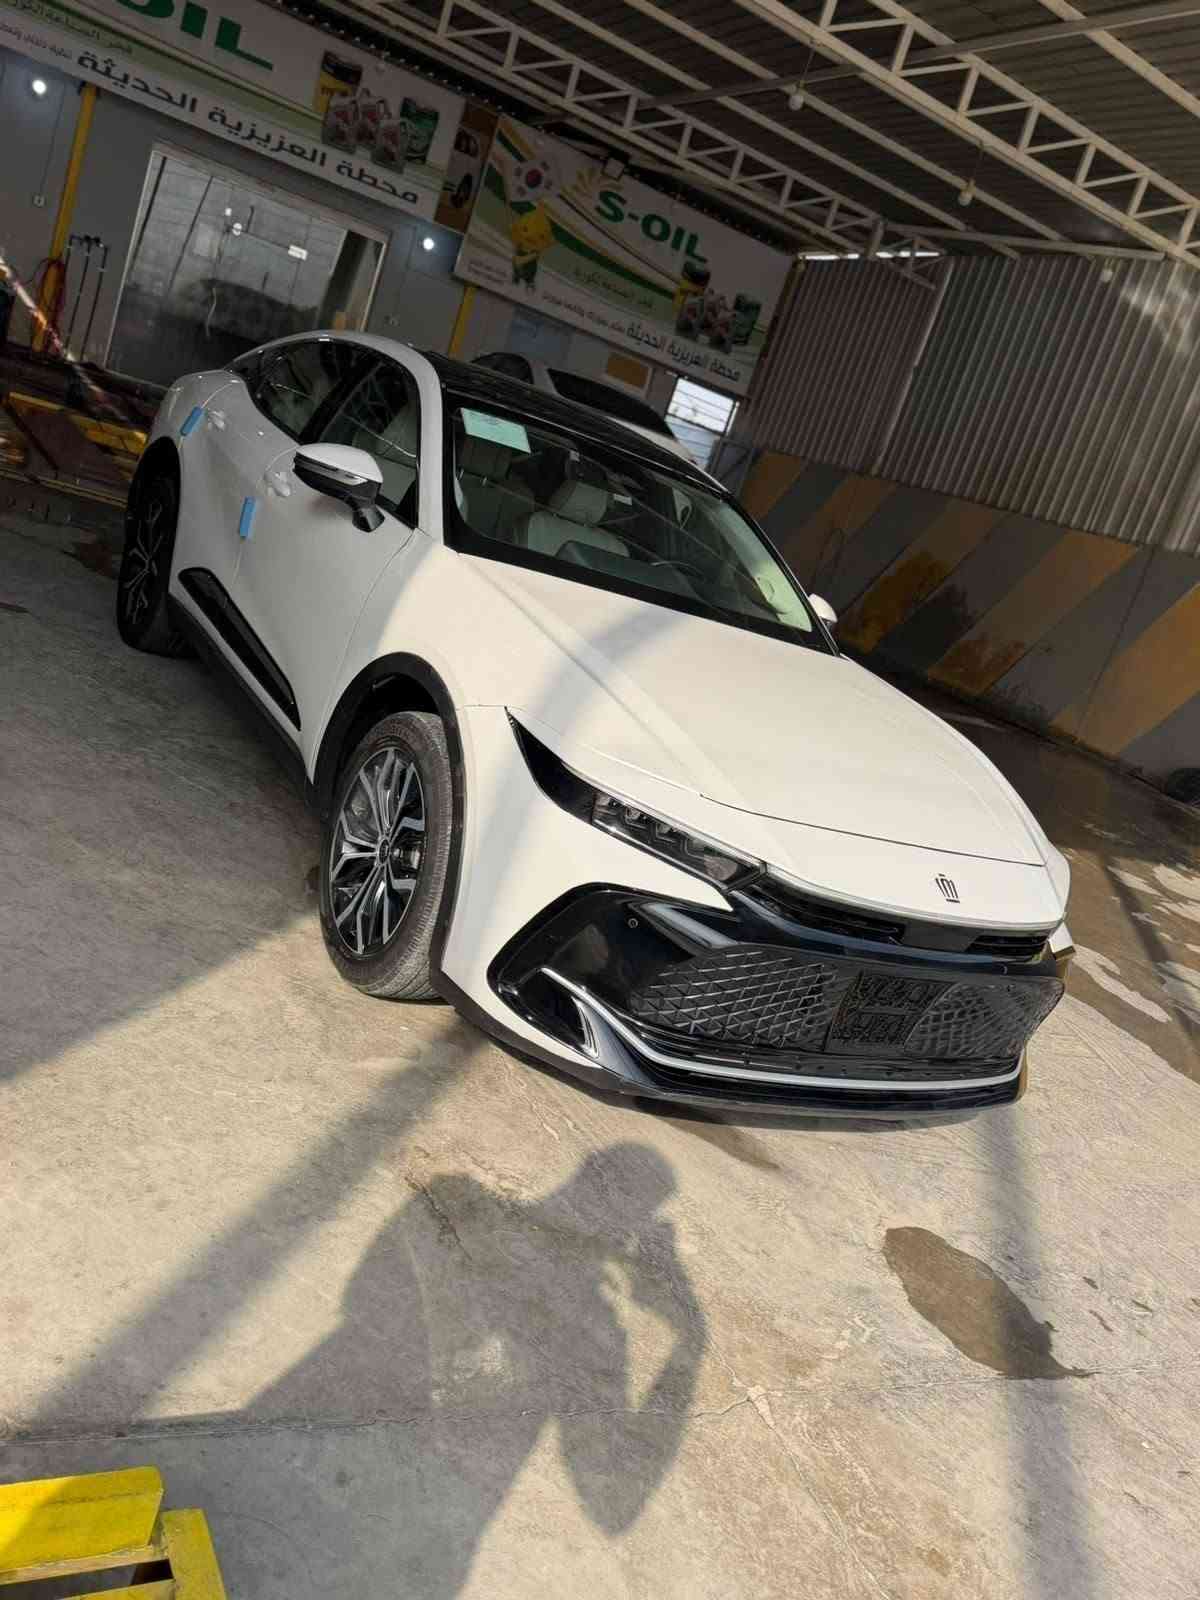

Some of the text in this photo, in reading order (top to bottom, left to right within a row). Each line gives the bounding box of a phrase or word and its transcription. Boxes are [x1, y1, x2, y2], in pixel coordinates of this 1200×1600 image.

[77, 49, 420, 205] محطة العزيزية الحديثة
[595, 190, 708, 264] S-OIL
[709, 357, 741, 383] محطة
